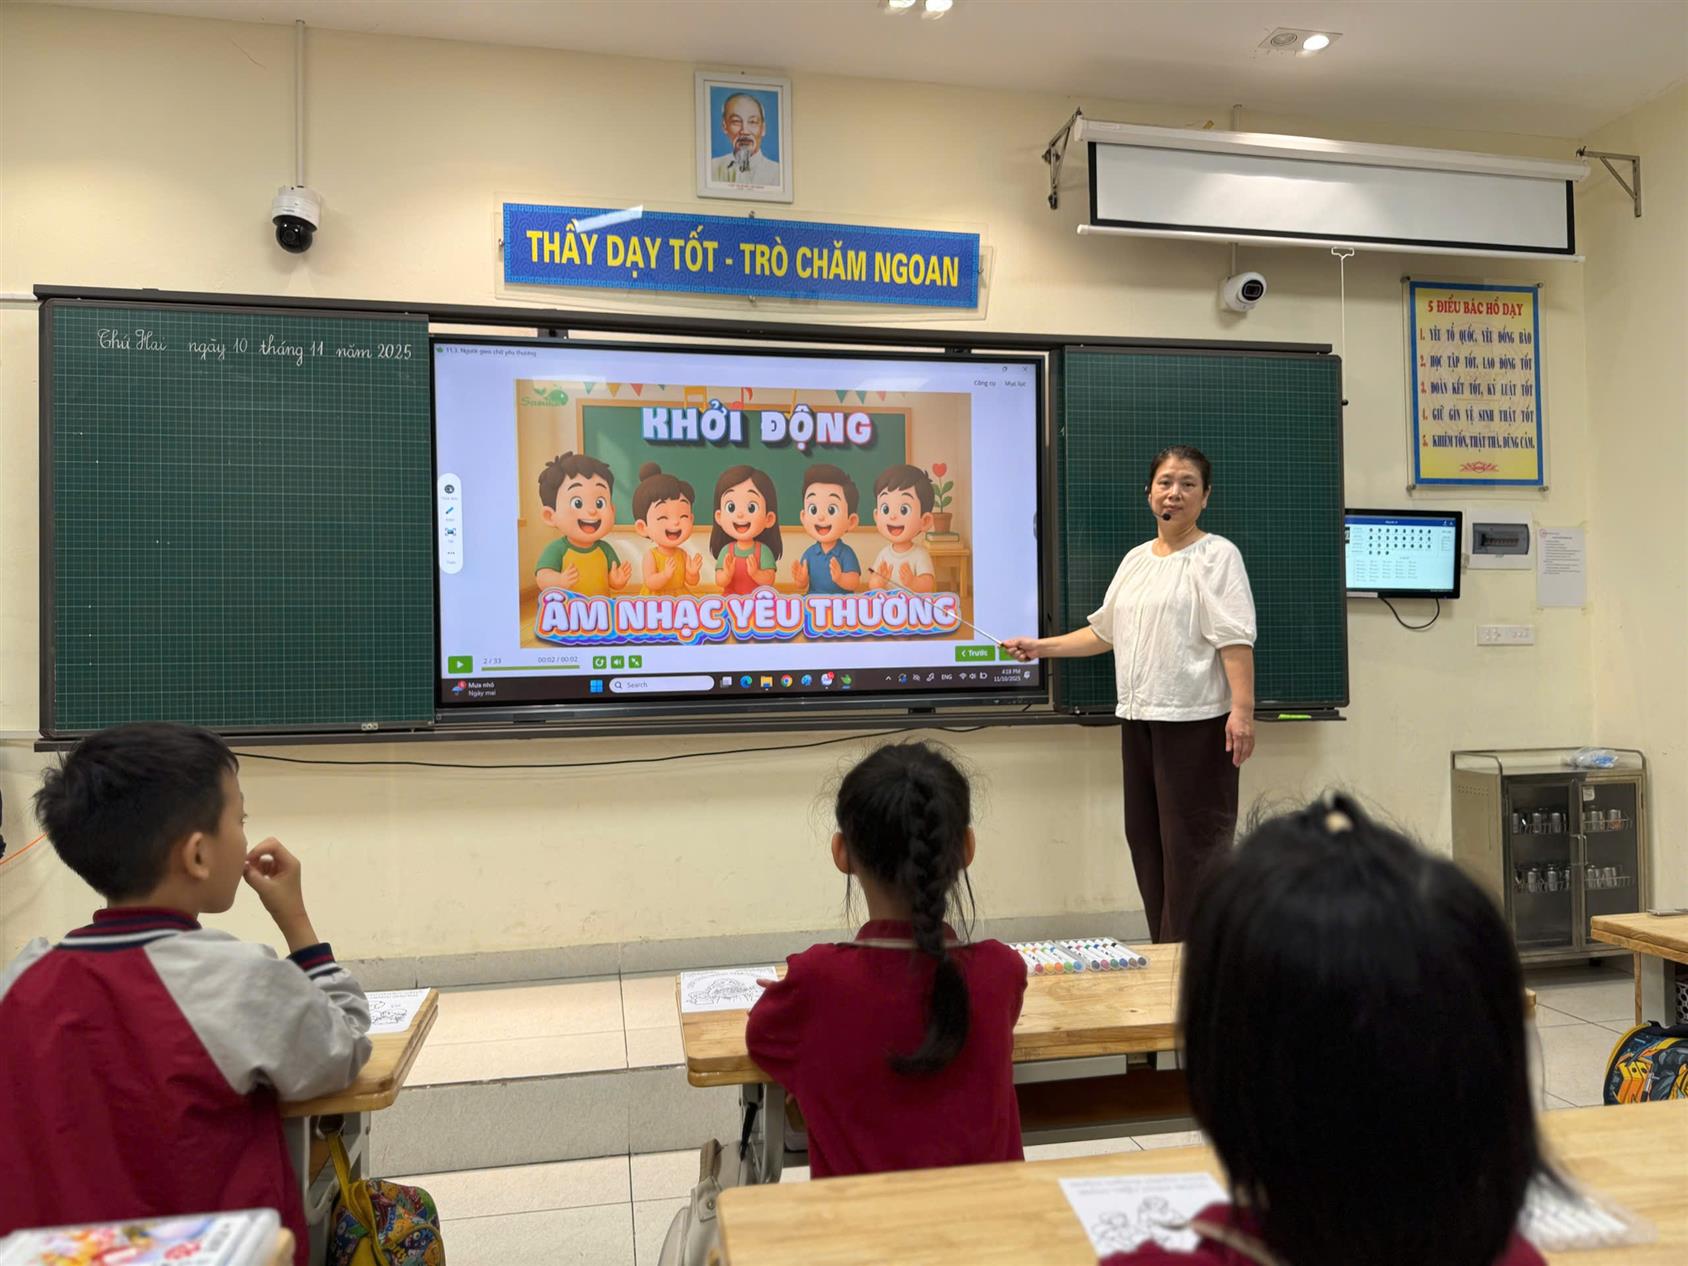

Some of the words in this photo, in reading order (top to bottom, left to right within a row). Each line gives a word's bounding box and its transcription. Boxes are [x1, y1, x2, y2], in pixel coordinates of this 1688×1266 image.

[606, 234, 662, 279] DẠY
[669, 224, 718, 272] TỐT
[740, 237, 788, 277] TRÒ
[796, 240, 867, 282] CHĂM
[874, 252, 959, 288] NGOAN
[1427, 300, 1433, 312] 5
[1463, 298, 1483, 314] BÁC
[1486, 297, 1500, 315] HỒ
[1502, 303, 1524, 319] DẠY
[97, 327, 131, 350] Thứ
[135, 328, 168, 351] Hai
[187, 336, 226, 361] ngày
[233, 338, 248, 353] 10
[258, 334, 304, 367] tháng
[310, 340, 324, 357] 11
[335, 343, 373, 359] năm
[377, 343, 413, 360] 2025
[642, 399, 743, 442] KHỞI
[761, 404, 872, 450] ĐỘNG
[541, 591, 610, 632] ÂM
[618, 600, 723, 637] NHẠC
[729, 591, 799, 629] YÊU
[808, 593, 956, 627] THƯƠNG
[627, 681, 648, 689] Search
